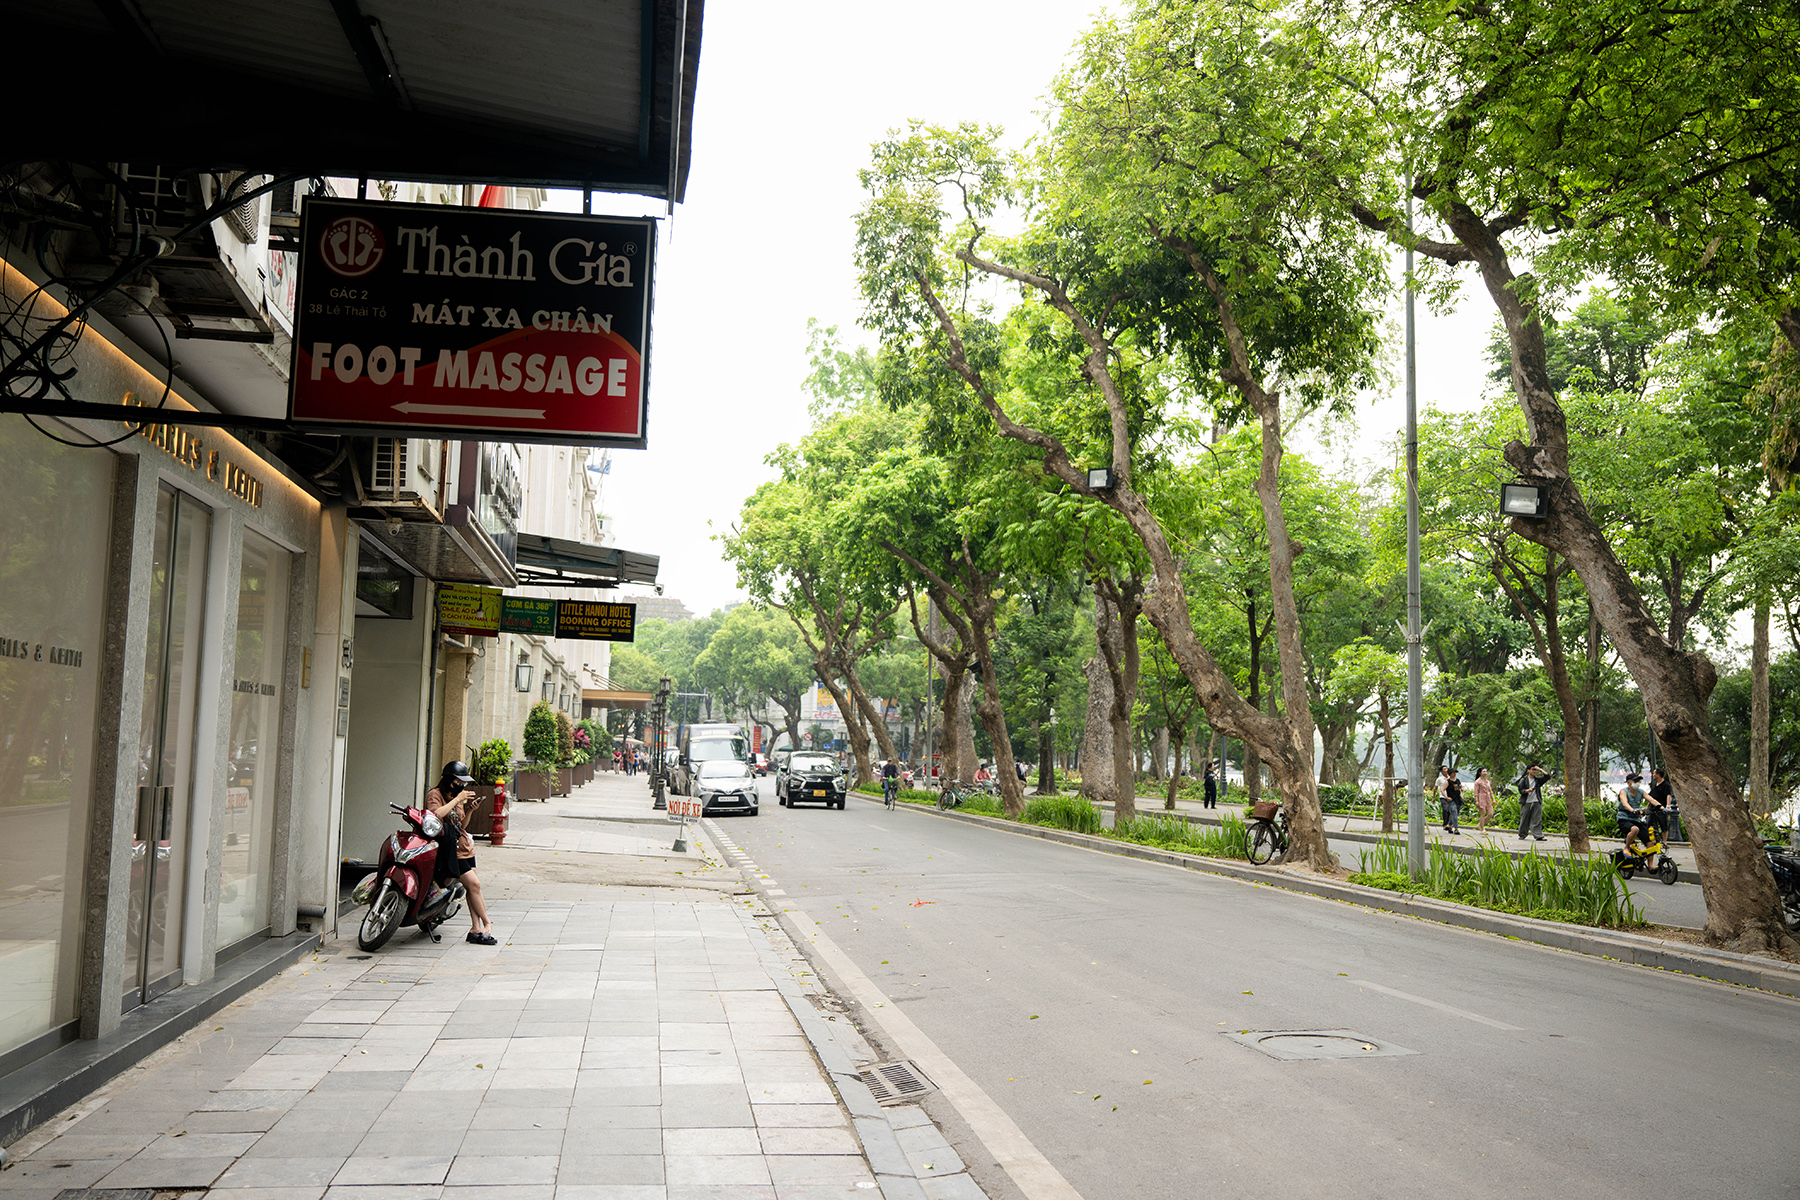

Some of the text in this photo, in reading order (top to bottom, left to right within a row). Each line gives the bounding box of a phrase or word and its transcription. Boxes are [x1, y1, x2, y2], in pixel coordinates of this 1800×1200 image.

[397, 225, 633, 287] Thành Gia
[361, 290, 368, 300] 2
[308, 303, 323, 314] 38
[326, 304, 340, 315] Lê
[344, 305, 369, 317] Thái
[411, 298, 614, 334] MÁT XA CHÂN
[310, 342, 628, 397] FOOT MASSAGE
[225, 461, 263, 508] KEITH
[560, 603, 631, 618] LITTLE HANOI HOTEL
[536, 616, 550, 625] 32
[560, 616, 632, 628] BOOKING OFFICE
[34, 643, 42, 662] &
[49, 646, 82, 668] KEITH
[692, 803, 701, 817] XE
